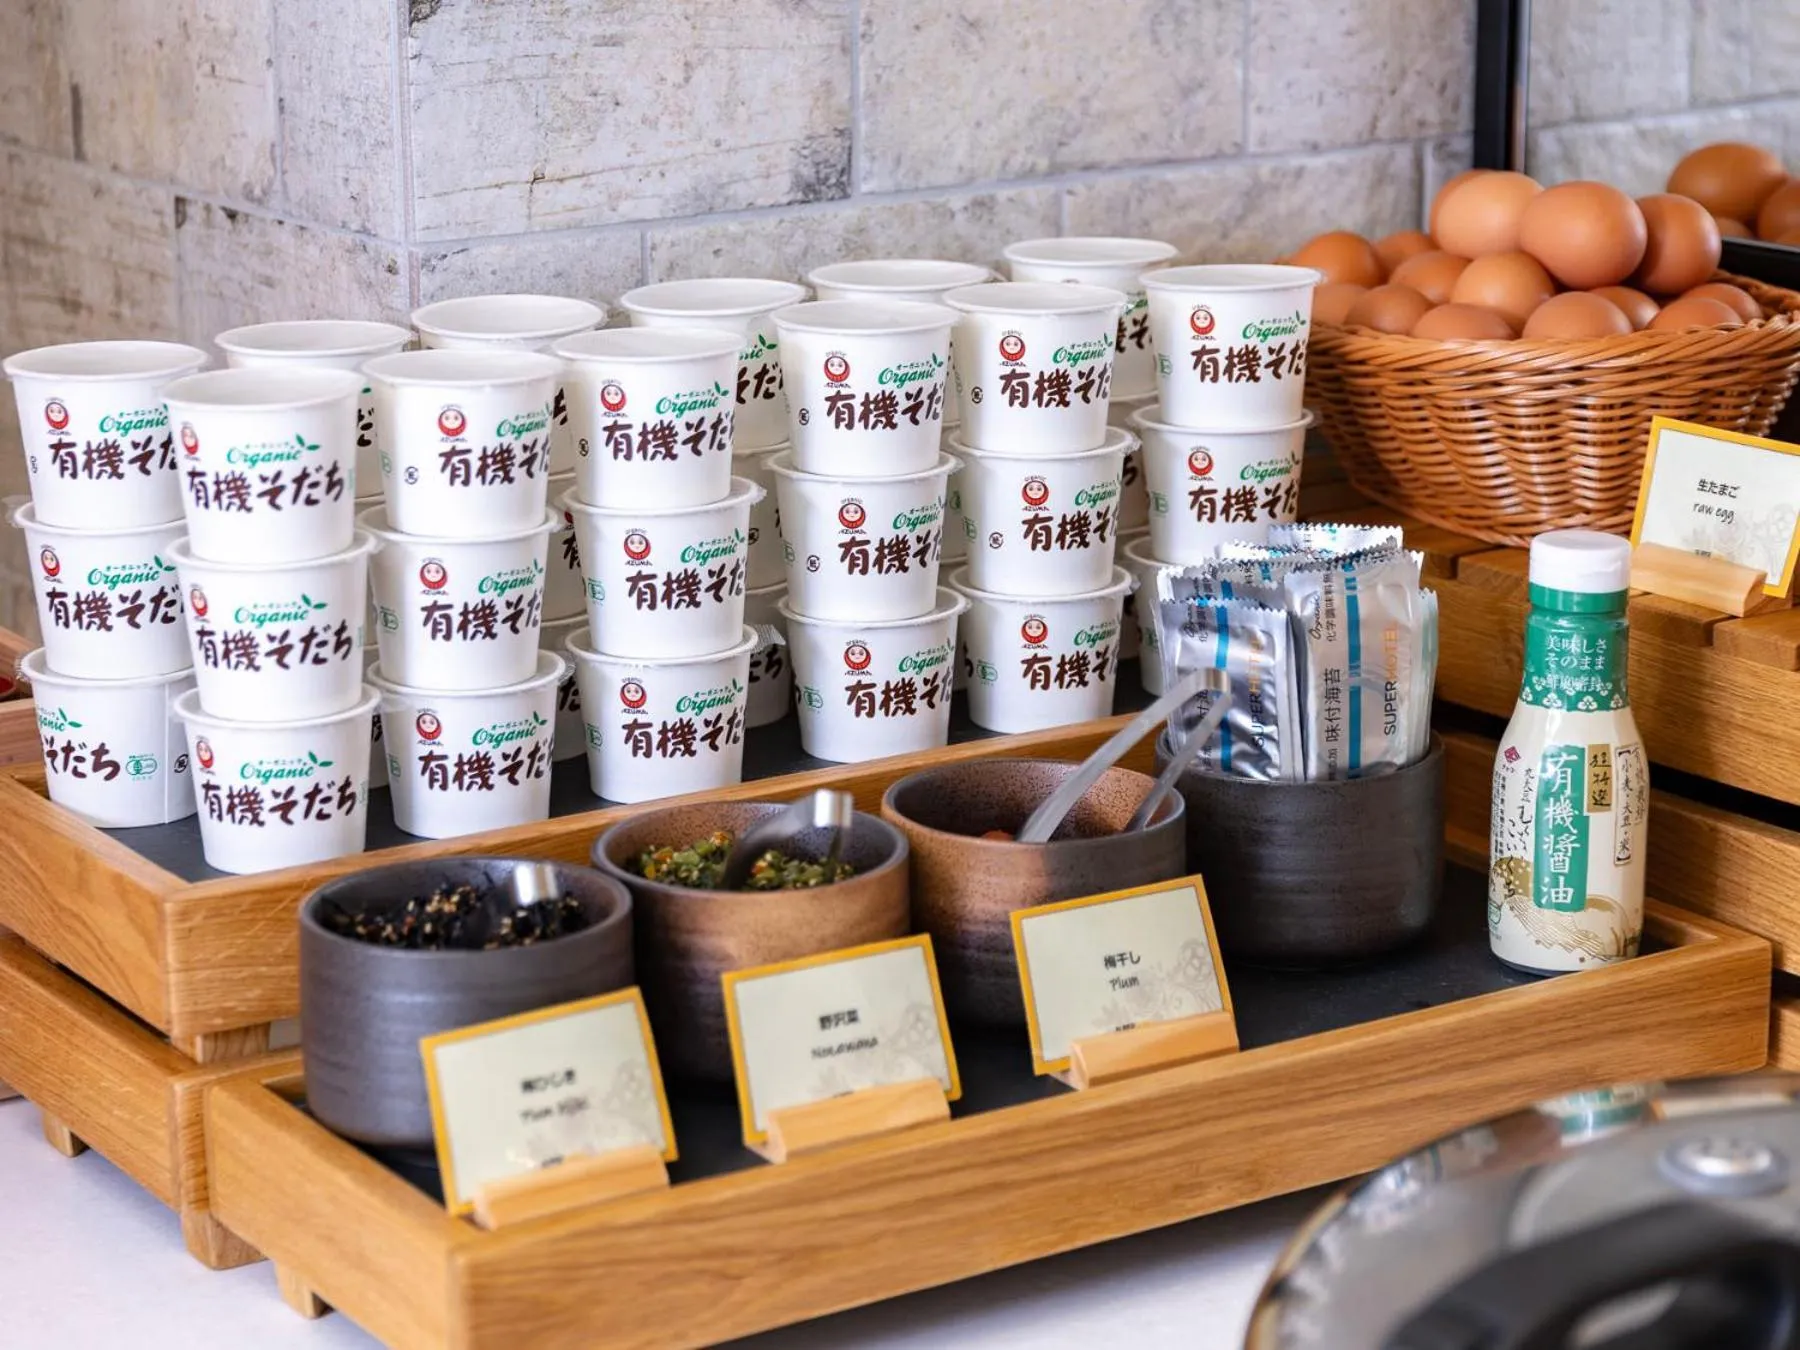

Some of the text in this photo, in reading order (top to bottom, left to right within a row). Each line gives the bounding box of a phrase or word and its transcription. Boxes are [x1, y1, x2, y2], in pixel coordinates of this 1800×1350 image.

[1242, 322, 1298, 343] Organic
[1052, 346, 1106, 368] Organic
[878, 367, 936, 389] Organic
[656, 397, 719, 419] Organic
[99, 415, 168, 437] Organic
[226, 446, 302, 469] Organic
[187, 460, 344, 512] 有機そだち
[1696, 478, 1741, 499] 生たまご
[1693, 502, 1735, 524] raw egg
[680, 544, 738, 566] Organic
[88, 568, 160, 590] Organic
[478, 574, 536, 597] Organic
[234, 605, 309, 628] Organic
[196, 619, 352, 671] 有機そだち
[1546, 634, 1607, 654] 美味しさ
[1544, 652, 1606, 670] そのまま
[676, 693, 735, 716] Organic
[1324, 668, 1341, 742] 味付海苔
[472, 724, 536, 749] Organic
[240, 762, 314, 784] Organic
[202, 775, 356, 827] 有機そだち
[1104, 951, 1141, 971] 梅干し
[1110, 976, 1140, 992] Plum
